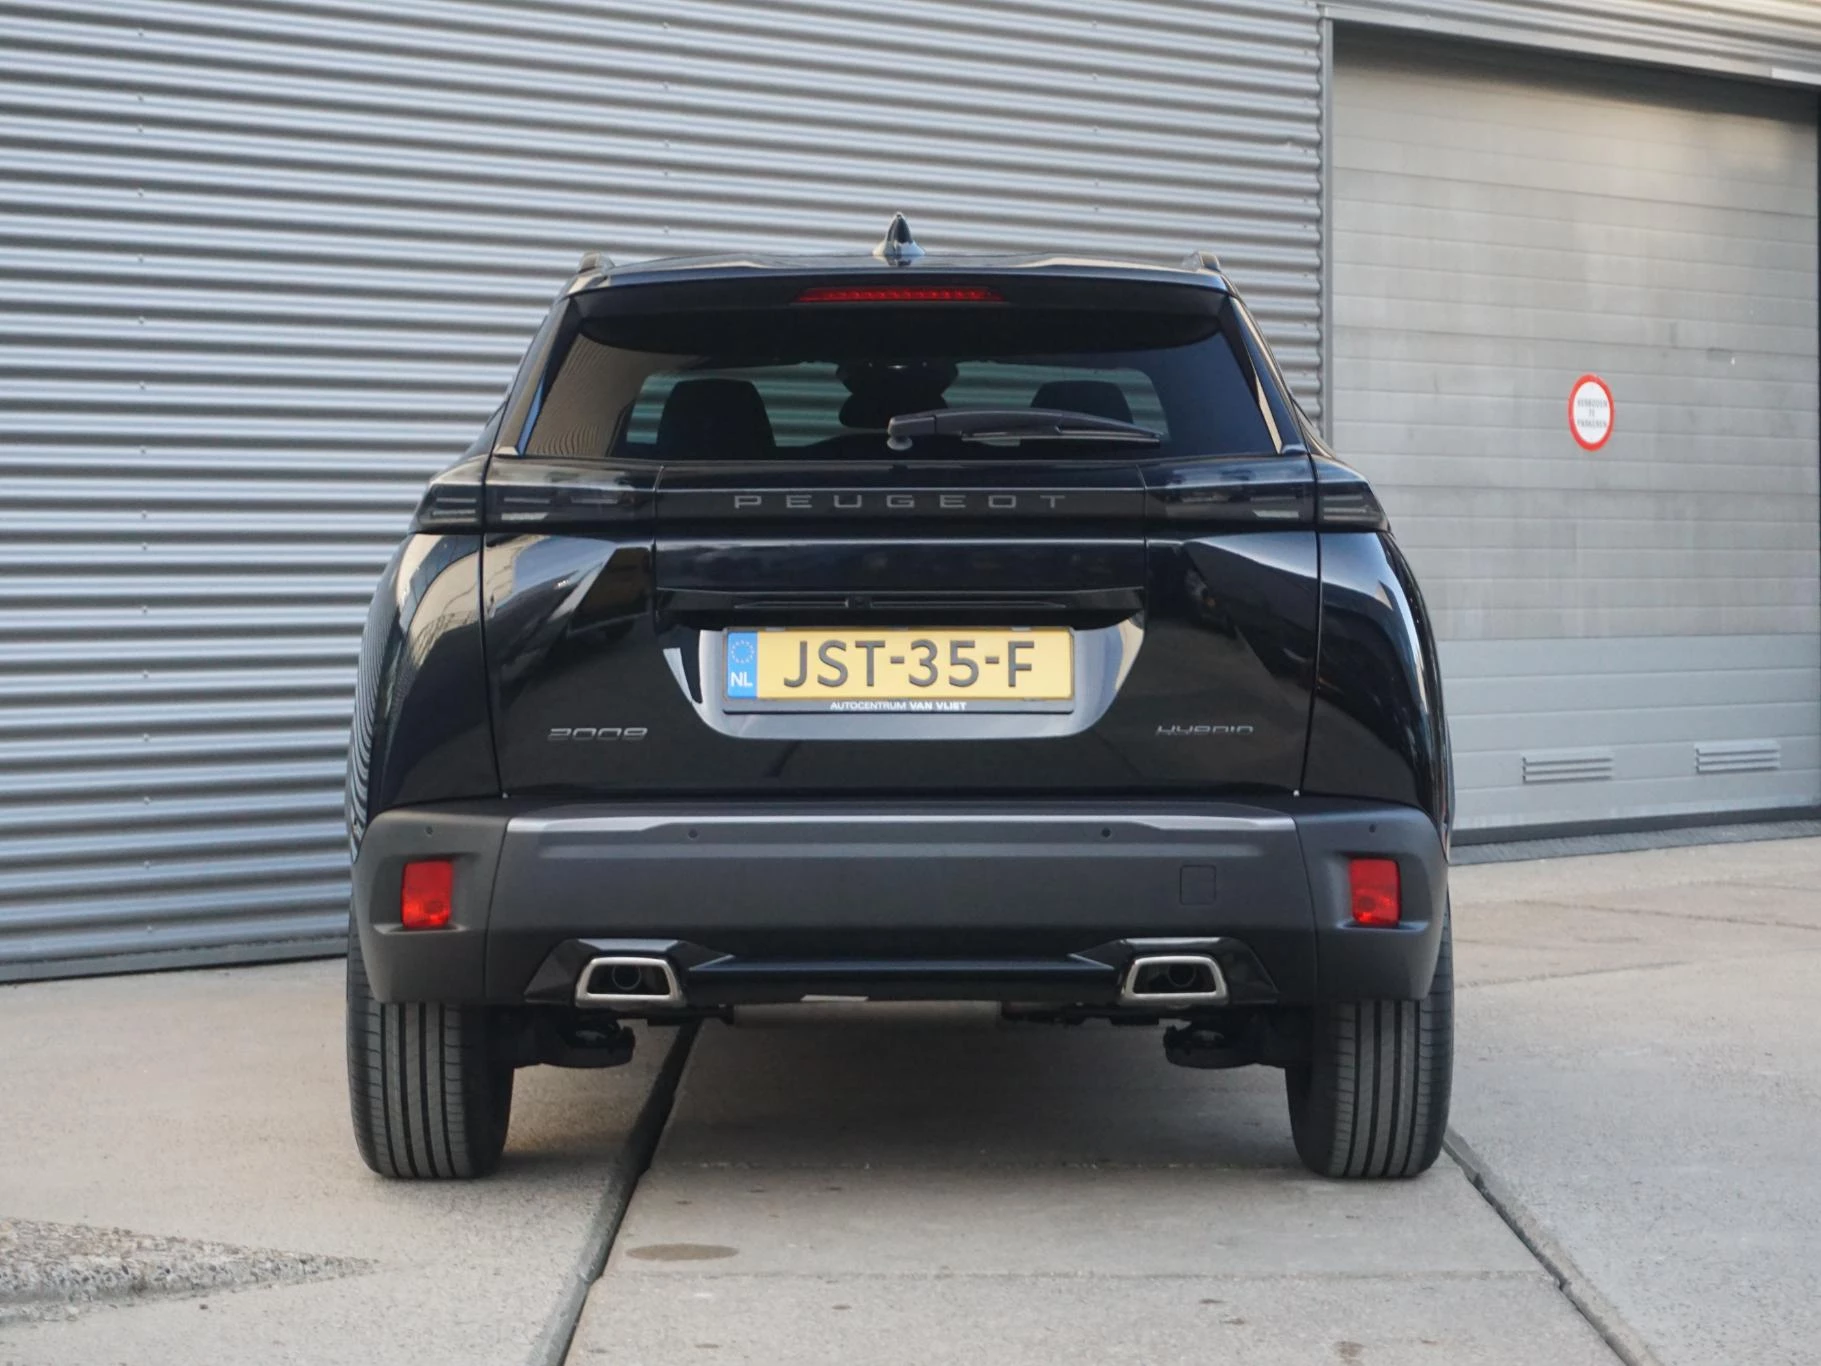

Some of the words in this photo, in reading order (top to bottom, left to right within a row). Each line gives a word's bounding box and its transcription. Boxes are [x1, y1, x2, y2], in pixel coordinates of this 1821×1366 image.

[733, 494, 1066, 509] PEUGEOT
[783, 639, 1035, 688] JST-35-F
[730, 671, 753, 687] NL
[829, 701, 906, 711] AUTOCENTRUM
[909, 701, 933, 711] VAN
[936, 701, 967, 711] VLIET
